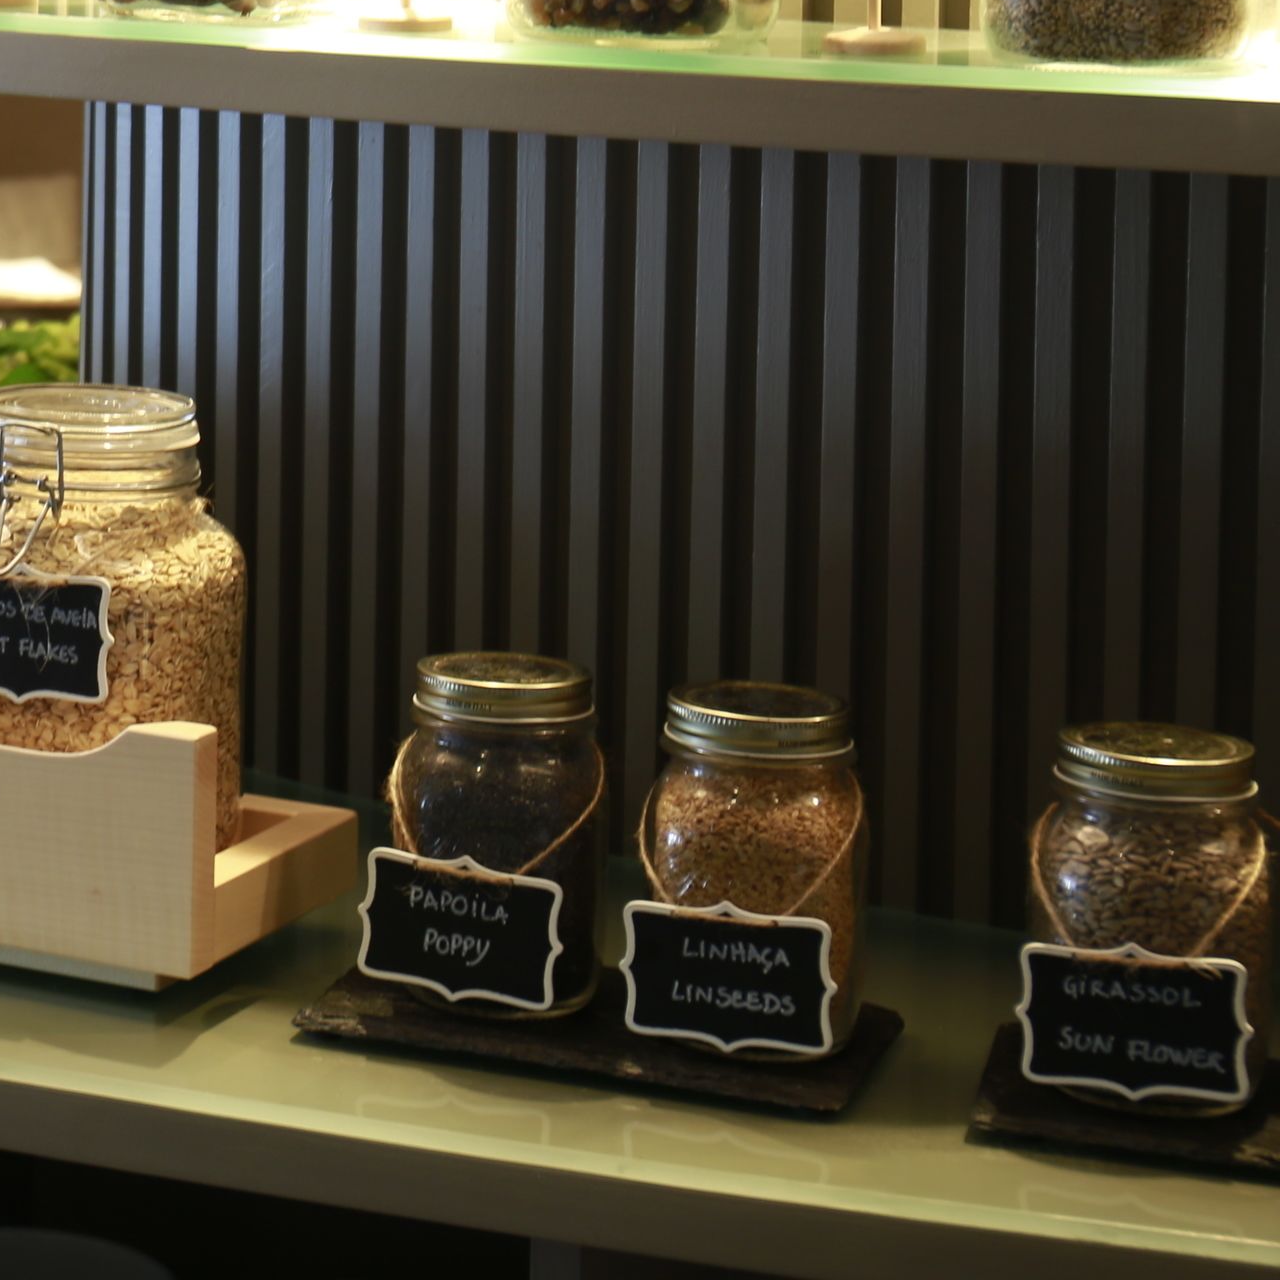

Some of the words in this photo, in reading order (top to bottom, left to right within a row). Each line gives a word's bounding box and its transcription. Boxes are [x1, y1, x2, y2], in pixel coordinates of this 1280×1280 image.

[19, 637, 79, 665] FLAKES
[423, 927, 490, 967] POPPY
[682, 937, 790, 975] LINHAÇA
[1058, 1026, 1115, 1054] SUN
[1128, 1038, 1226, 1075] FLOWER
